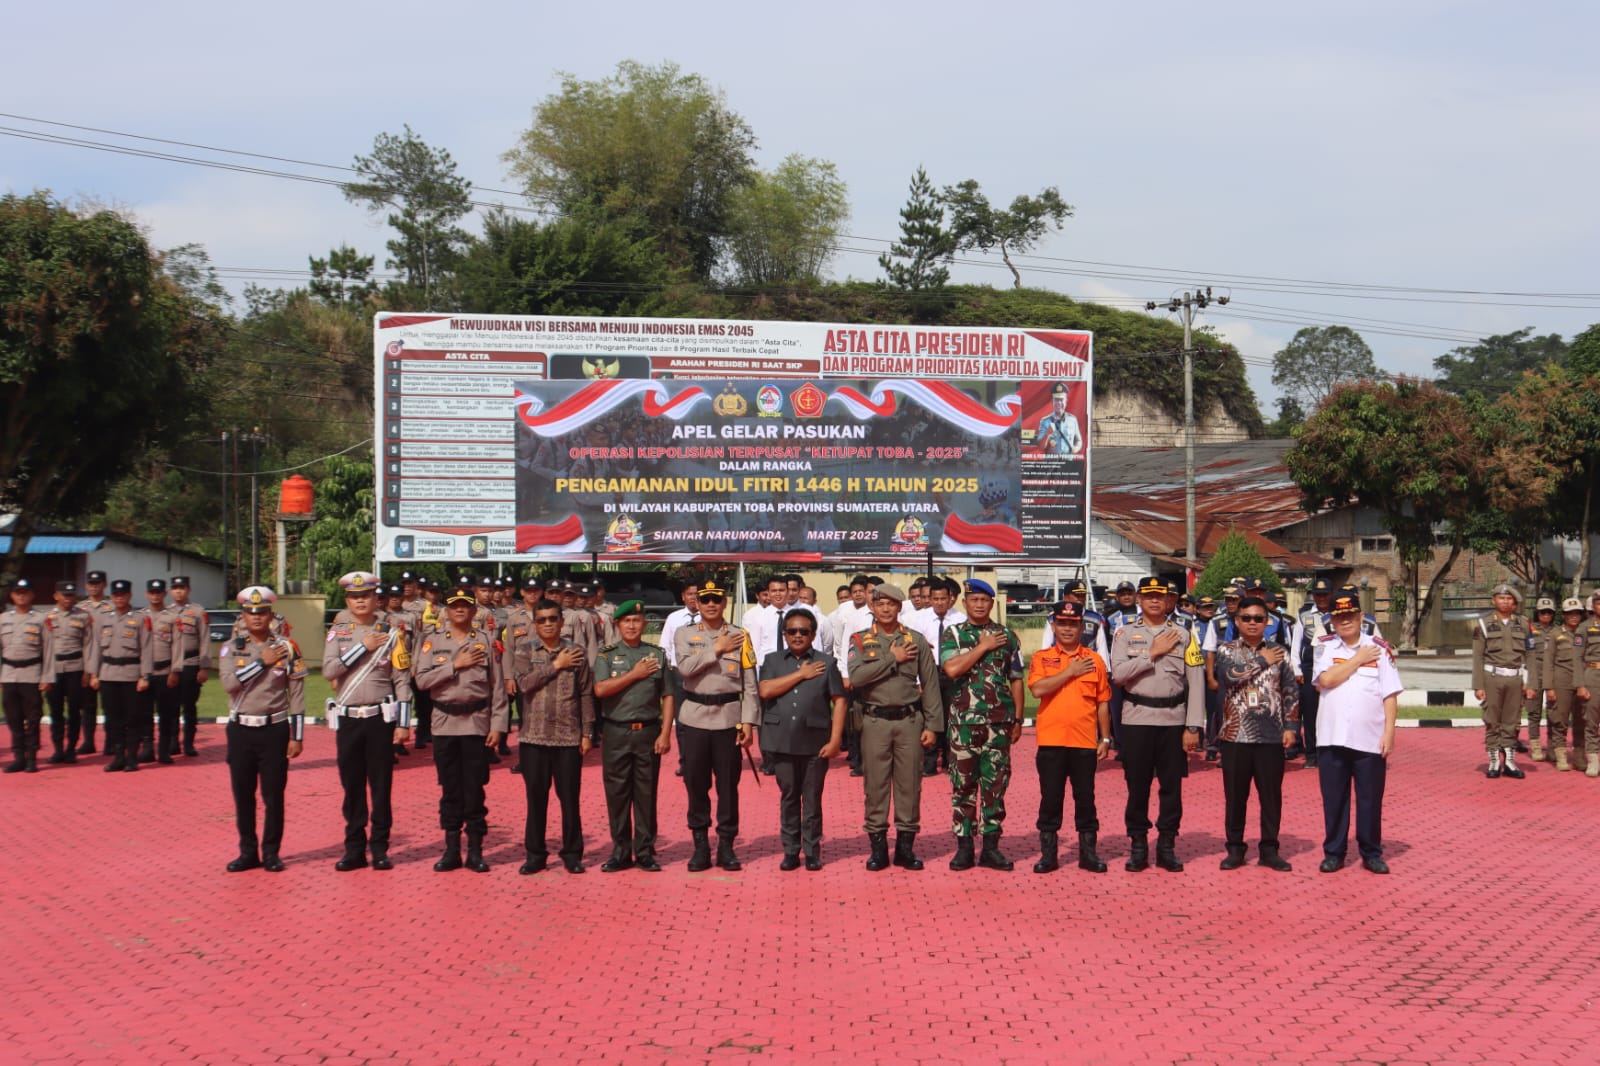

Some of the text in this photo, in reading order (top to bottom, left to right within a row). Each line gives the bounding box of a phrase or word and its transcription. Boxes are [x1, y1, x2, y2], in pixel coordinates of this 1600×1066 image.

[450, 319, 754, 336] MEWUJUDKAN VISI BERSAMA MENUJU INDONESIA EMAS 2045
[823, 329, 1025, 358] ASTA CITA PRESIDEN RI
[670, 360, 706, 368] ARAHAN
[708, 360, 749, 368] PRESIDEN
[822, 356, 1084, 378] DAN PROGRAM PRIORITAS KAPOLDA SUMUT
[672, 424, 866, 439] APEL GELAR PASUKAN
[569, 446, 634, 459] OPERASI
[637, 446, 724, 459] KEPOLISIAN
[728, 446, 800, 459] TERPUSAT
[876, 446, 915, 459] TOBA
[720, 461, 812, 471] DALAM RANGKA
[556, 477, 979, 493] PENGAMANAN IDUL FITRI 1446 H TAHUN 2025
[604, 502, 940, 513] DI WILAYAH KABUPATEN TOBA PROVINSI SUMATERA UTARA
[653, 530, 785, 542] SIANTAR NARUMONDA,
[806, 530, 879, 540] MARET 2025
